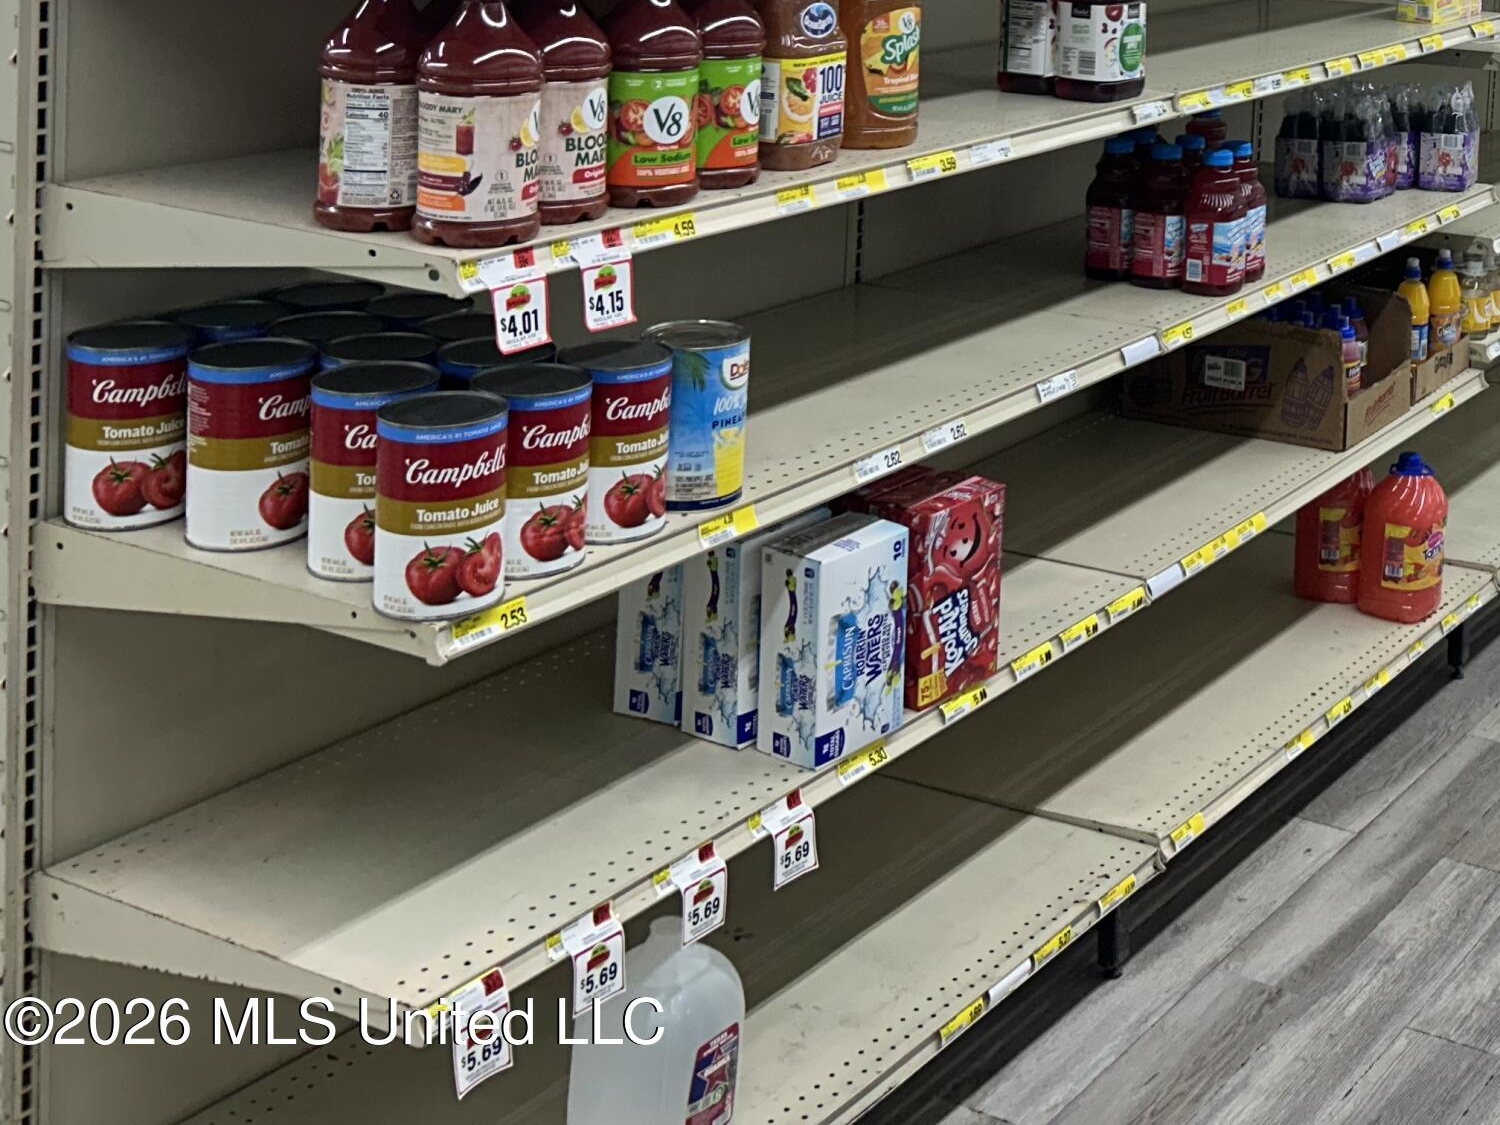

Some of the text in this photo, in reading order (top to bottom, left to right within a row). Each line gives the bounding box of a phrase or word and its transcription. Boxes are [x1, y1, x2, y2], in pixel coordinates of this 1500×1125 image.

[439, 106, 464, 114] MARY
[589, 95, 606, 123] V8
[820, 92, 843, 104] JUICE
[652, 103, 683, 136] V8
[634, 155, 657, 164] Low
[673, 219, 696, 238] 4.59
[589, 290, 625, 316] $4.15
[500, 309, 539, 338] $4.01
[102, 425, 155, 439] Tomato
[616, 439, 657, 455] Tomato
[405, 443, 506, 488] Campbell's
[533, 468, 576, 485] Tomato
[416, 497, 499, 522] Tomato Juice
[893, 540, 903, 561] 10
[500, 607, 528, 630] 2.53
[956, 588, 979, 654] Jammers
[865, 614, 883, 686] WATERS
[932, 597, 965, 678] Kool-Aid
[869, 746, 888, 766] 5.30
[781, 841, 809, 869] $5.69
[688, 897, 720, 926] $5.69
[580, 962, 617, 994] $5.69
[461, 1036, 502, 1072] $5.69
